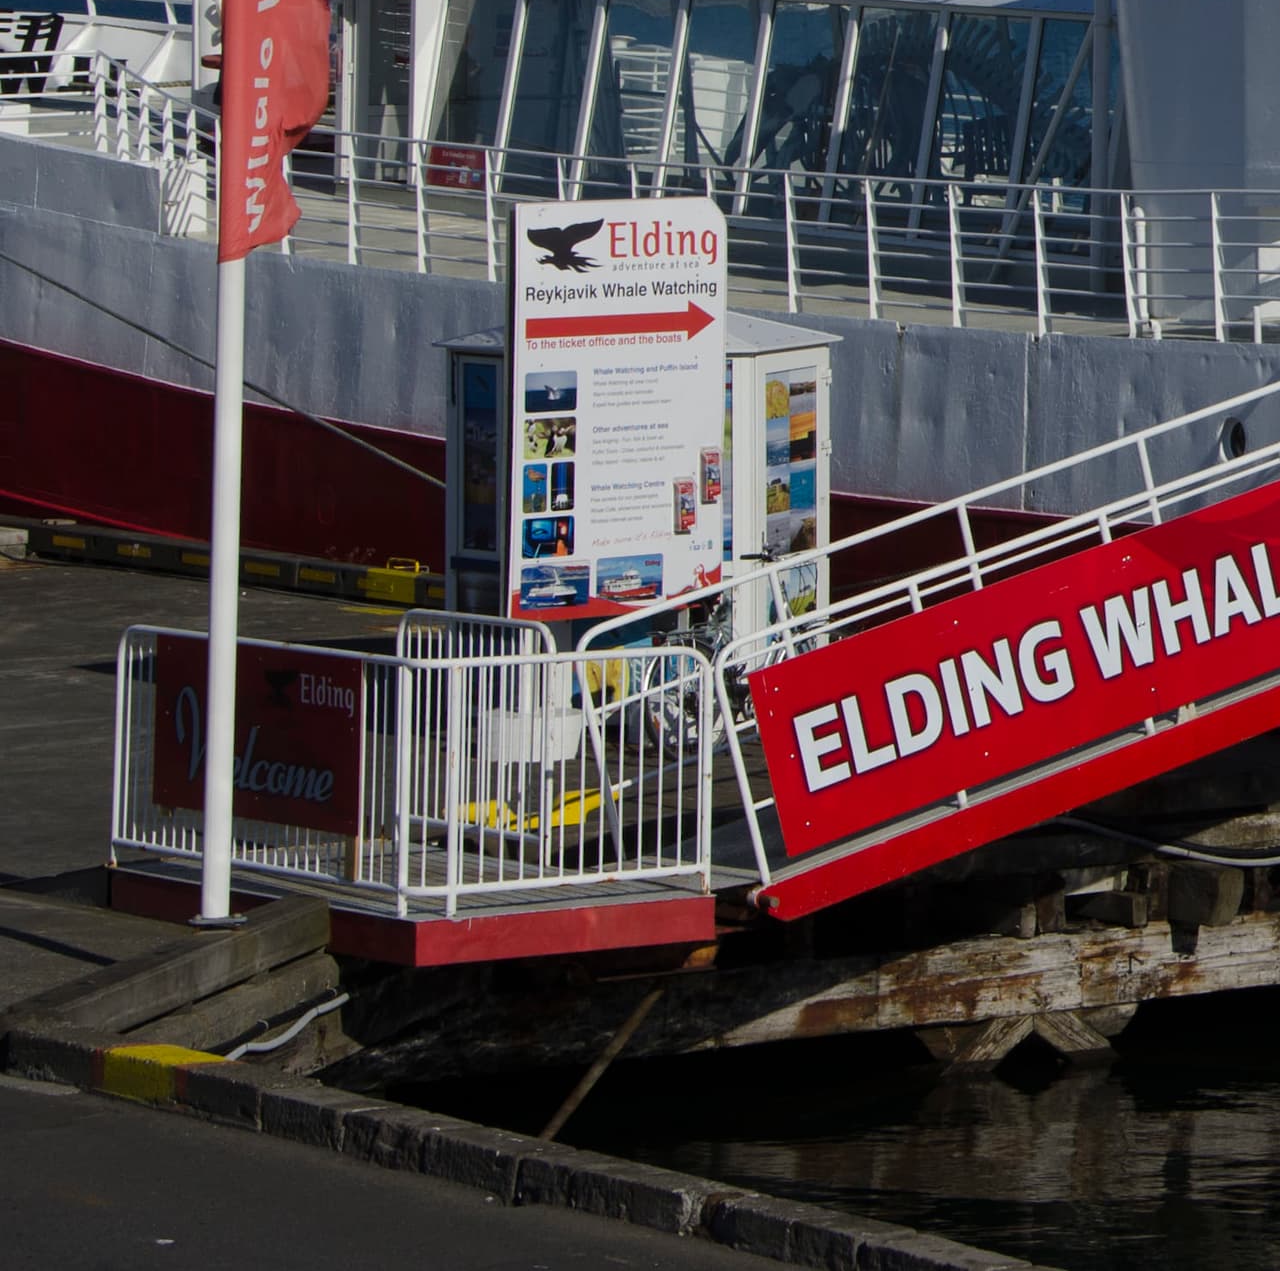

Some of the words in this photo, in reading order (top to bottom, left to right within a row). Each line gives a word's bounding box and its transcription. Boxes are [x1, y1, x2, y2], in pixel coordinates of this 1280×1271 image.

[607, 220, 718, 265] Elding
[612, 262, 666, 272] adventure
[669, 260, 681, 269] at
[683, 261, 700, 270] sea
[525, 283, 598, 304] Reykjavik
[602, 282, 647, 298] Whale
[651, 280, 717, 296] Watching
[526, 340, 538, 350] To
[541, 339, 557, 349] the
[559, 338, 586, 348] ticket
[588, 337, 615, 347] office
[617, 335, 636, 346] and
[638, 334, 654, 344] the
[656, 333, 682, 343] boats
[300, 673, 355, 718] Elding
[793, 620, 1075, 793] ELDING
